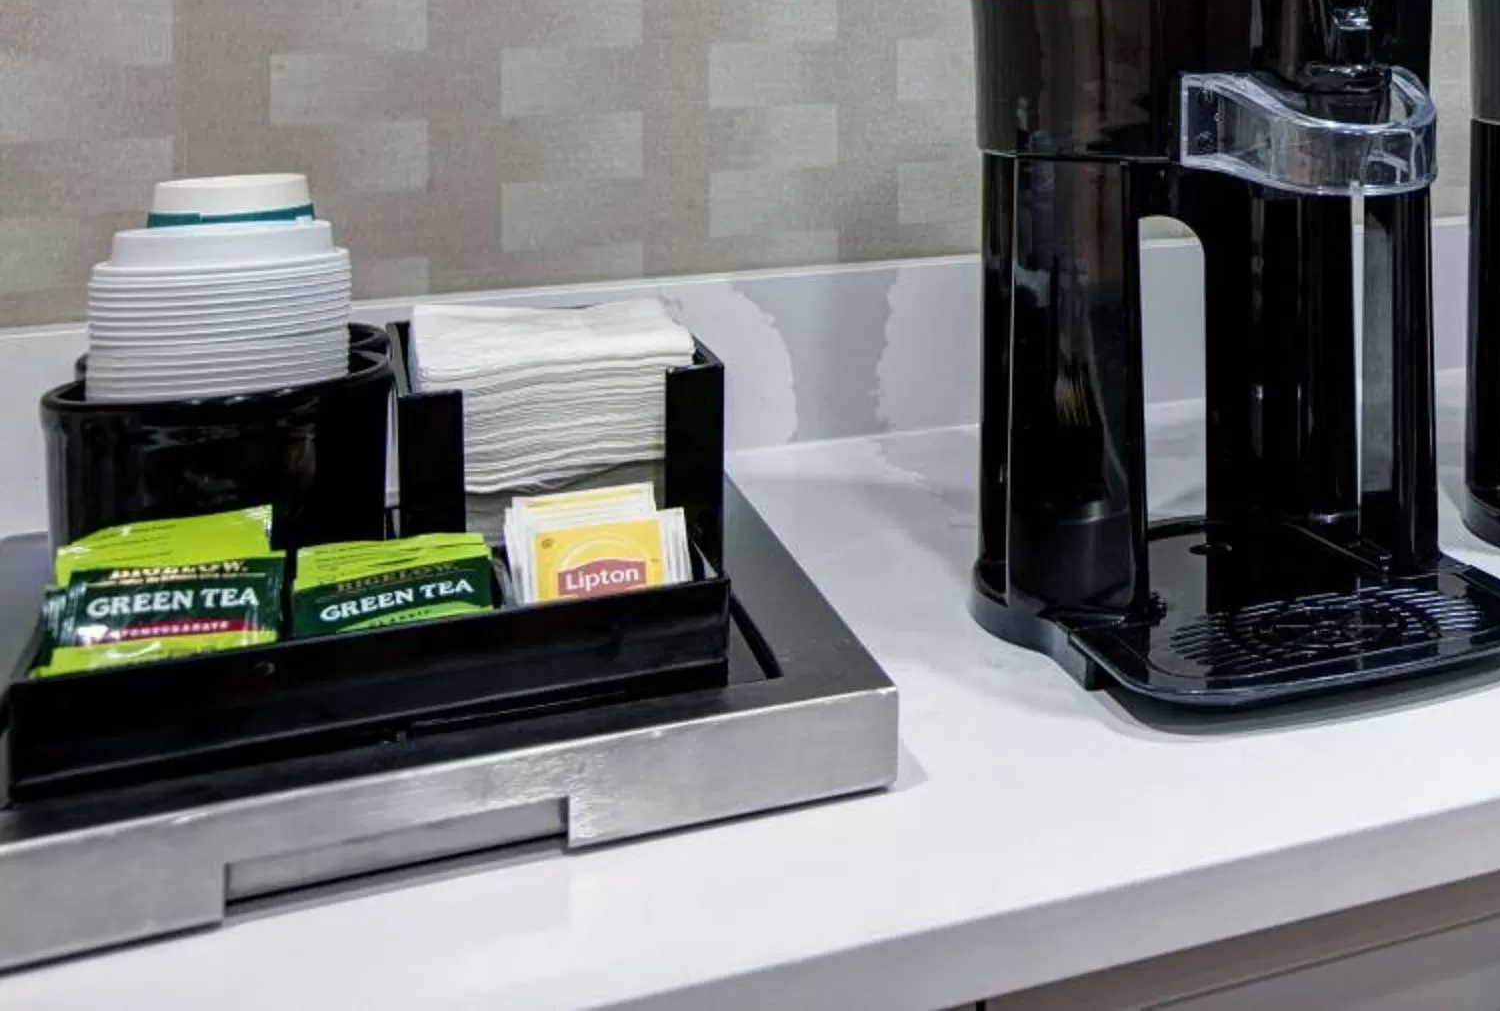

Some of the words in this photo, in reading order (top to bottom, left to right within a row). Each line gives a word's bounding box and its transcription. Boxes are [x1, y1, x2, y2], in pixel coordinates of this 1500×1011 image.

[564, 567, 640, 592] Lipton
[85, 589, 194, 618] GREEN
[200, 586, 260, 608] TEA
[319, 588, 414, 622] GREEN
[419, 578, 475, 599] TEA
